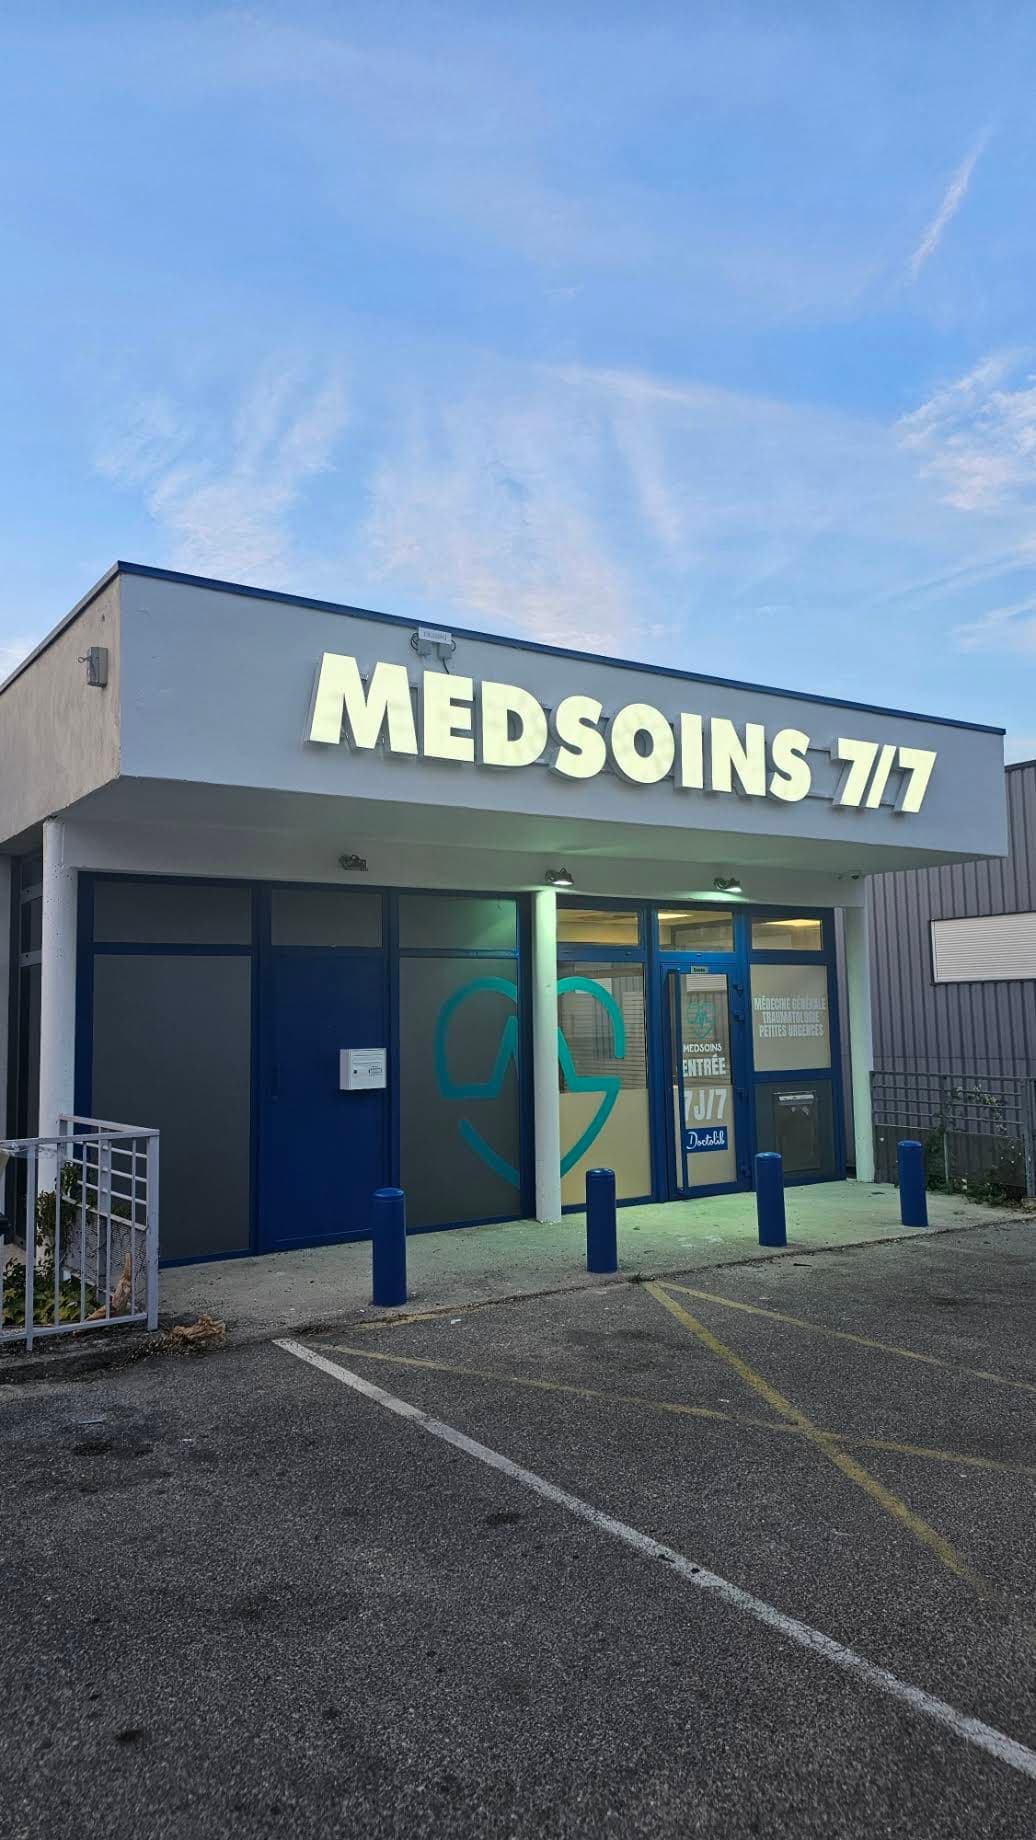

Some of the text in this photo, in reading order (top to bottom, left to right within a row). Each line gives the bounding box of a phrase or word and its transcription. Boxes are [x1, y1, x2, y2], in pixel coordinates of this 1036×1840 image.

[309, 652, 937, 813] MEDSOINS 7/7
[762, 1010, 819, 1023] TRAUMATOLOGIE
[759, 1023, 823, 1038] PETITES URGENCES
[683, 1043, 722, 1053] MEDSOINS
[683, 1053, 726, 1077] ENTRÉE
[686, 1130, 725, 1150] Doctolib
